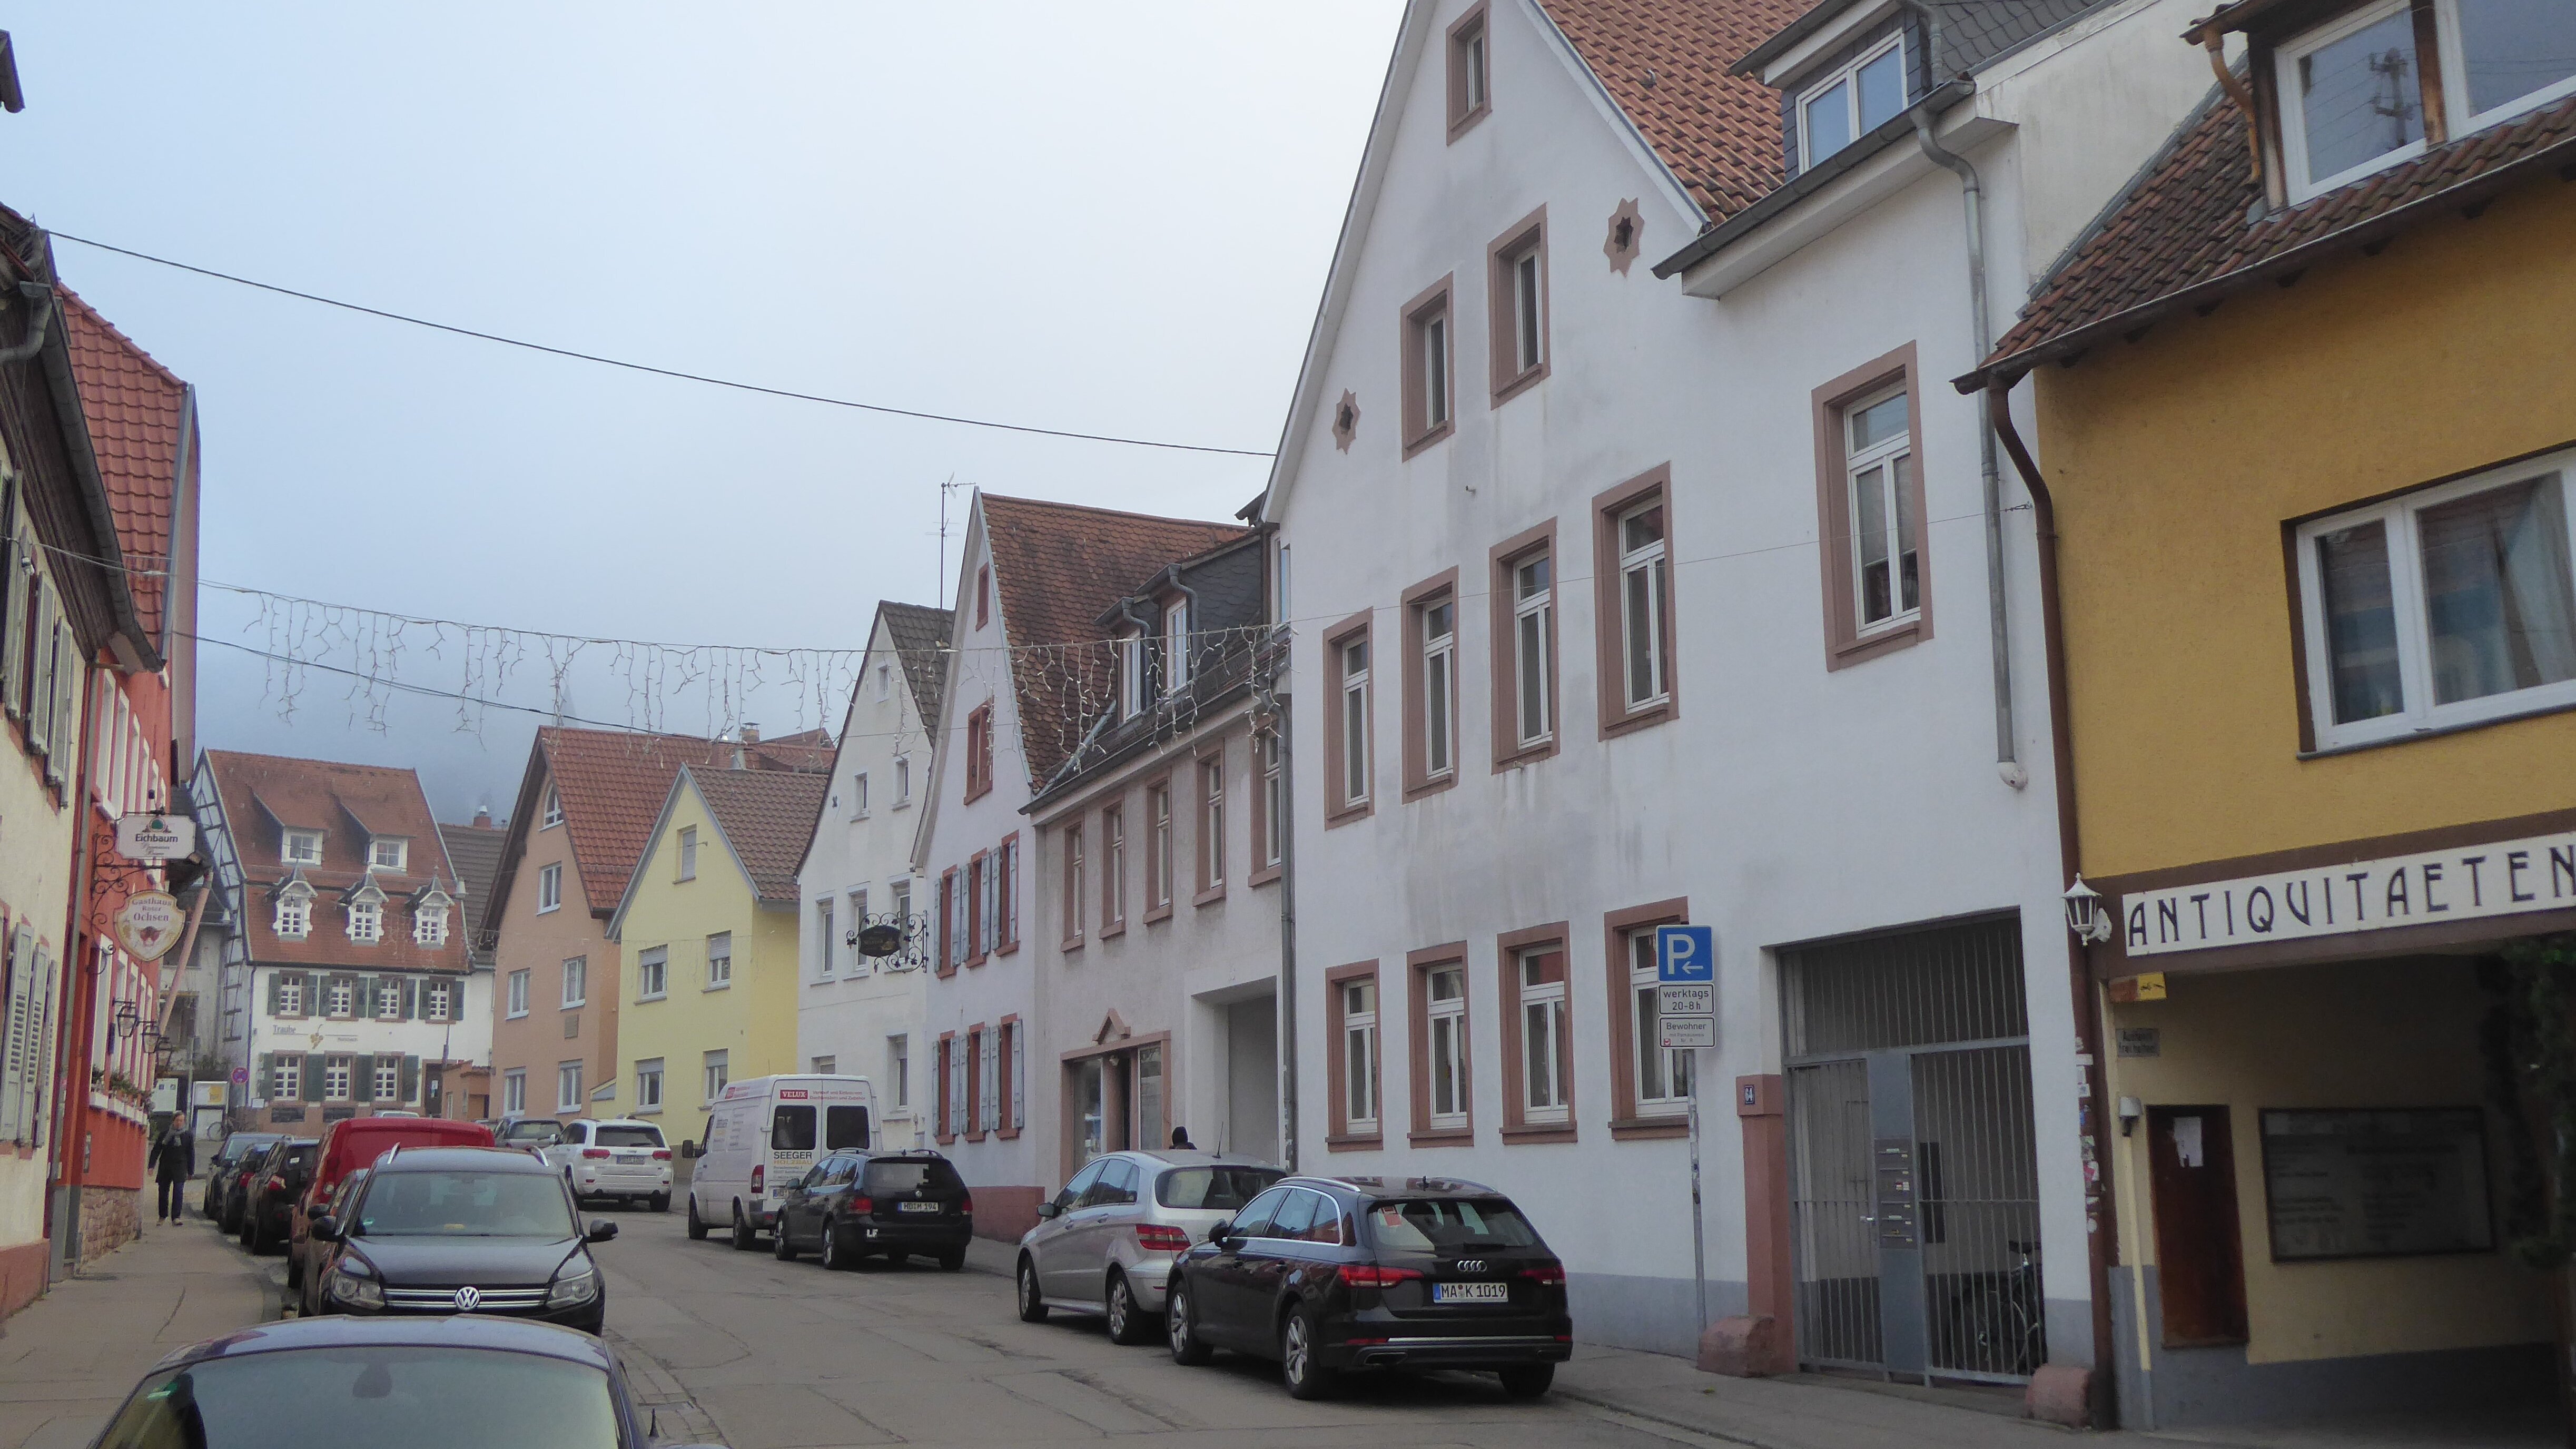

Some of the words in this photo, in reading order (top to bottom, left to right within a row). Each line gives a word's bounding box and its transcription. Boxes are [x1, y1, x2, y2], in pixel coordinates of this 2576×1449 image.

[2129, 845, 2576, 947] ANTIQUITAETEN
[134, 912, 169, 921] Ochsen
[1667, 934, 1695, 974] P
[1663, 989, 1709, 999] werktags
[1696, 1001, 1701, 1010] h
[273, 1024, 296, 1033] Traube
[1441, 1285, 1457, 1298] MA
[1466, 1285, 1473, 1297] K
[1476, 1284, 1505, 1297] 1019
